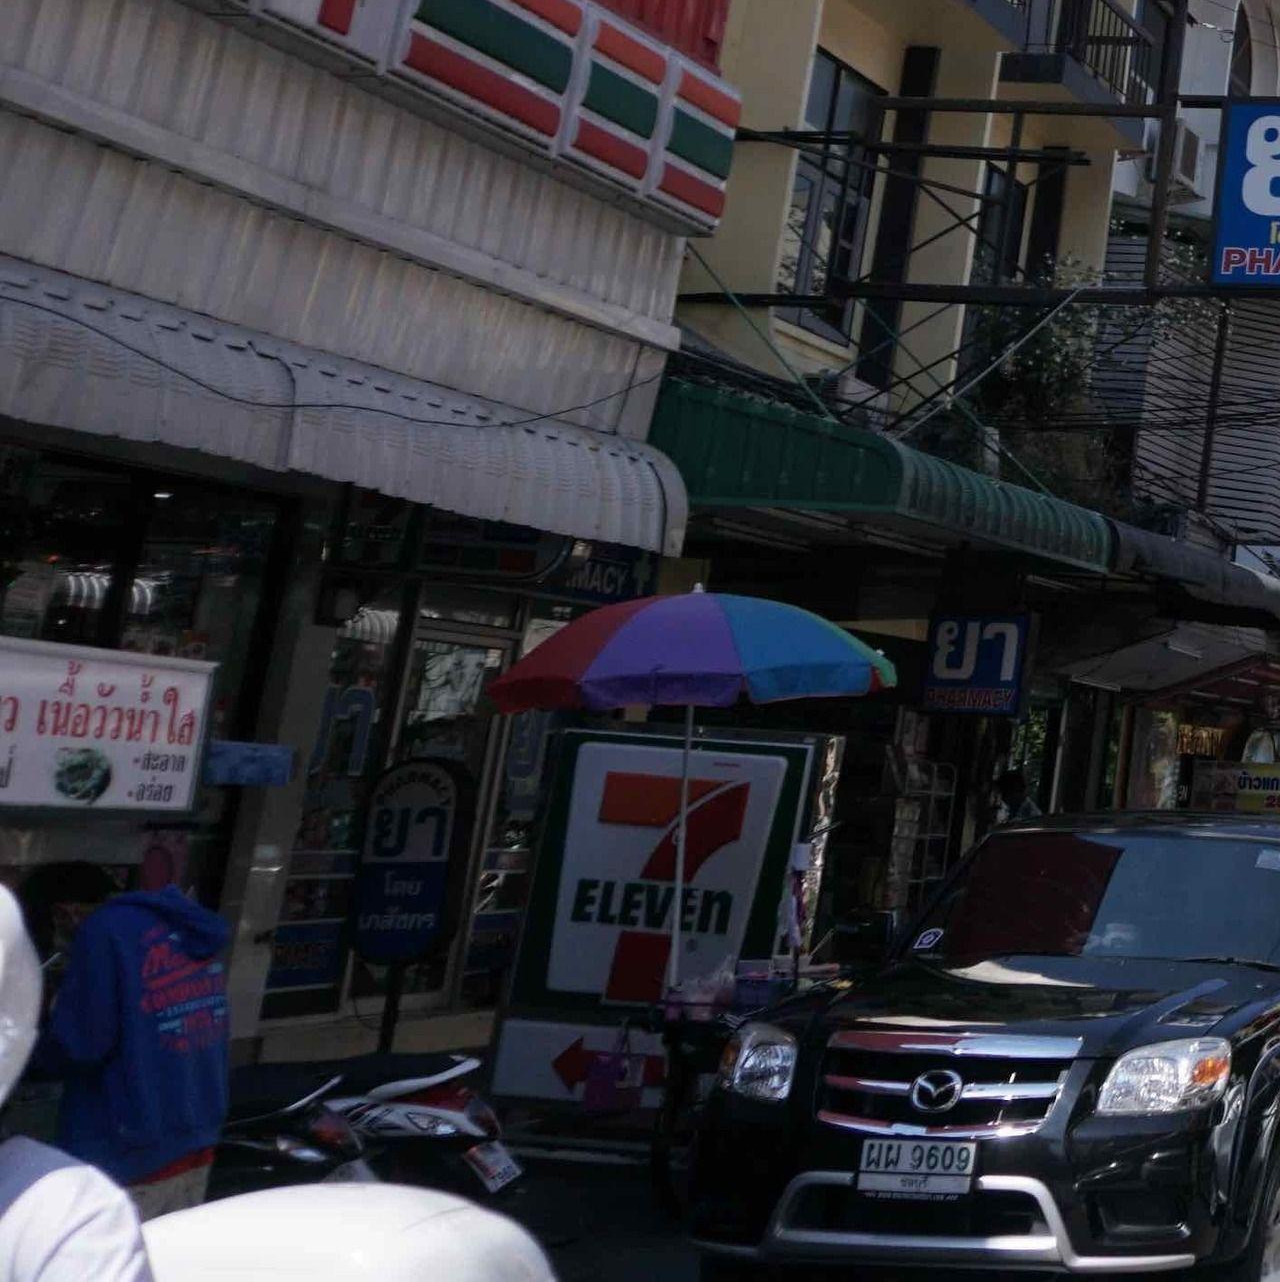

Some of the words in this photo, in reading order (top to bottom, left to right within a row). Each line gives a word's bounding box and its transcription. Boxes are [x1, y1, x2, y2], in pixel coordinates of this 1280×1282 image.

[933, 620, 1019, 681] ยา
[928, 687, 1016, 710] PHARMACY
[373, 806, 449, 857] ยา
[911, 1145, 971, 1171] 9609
